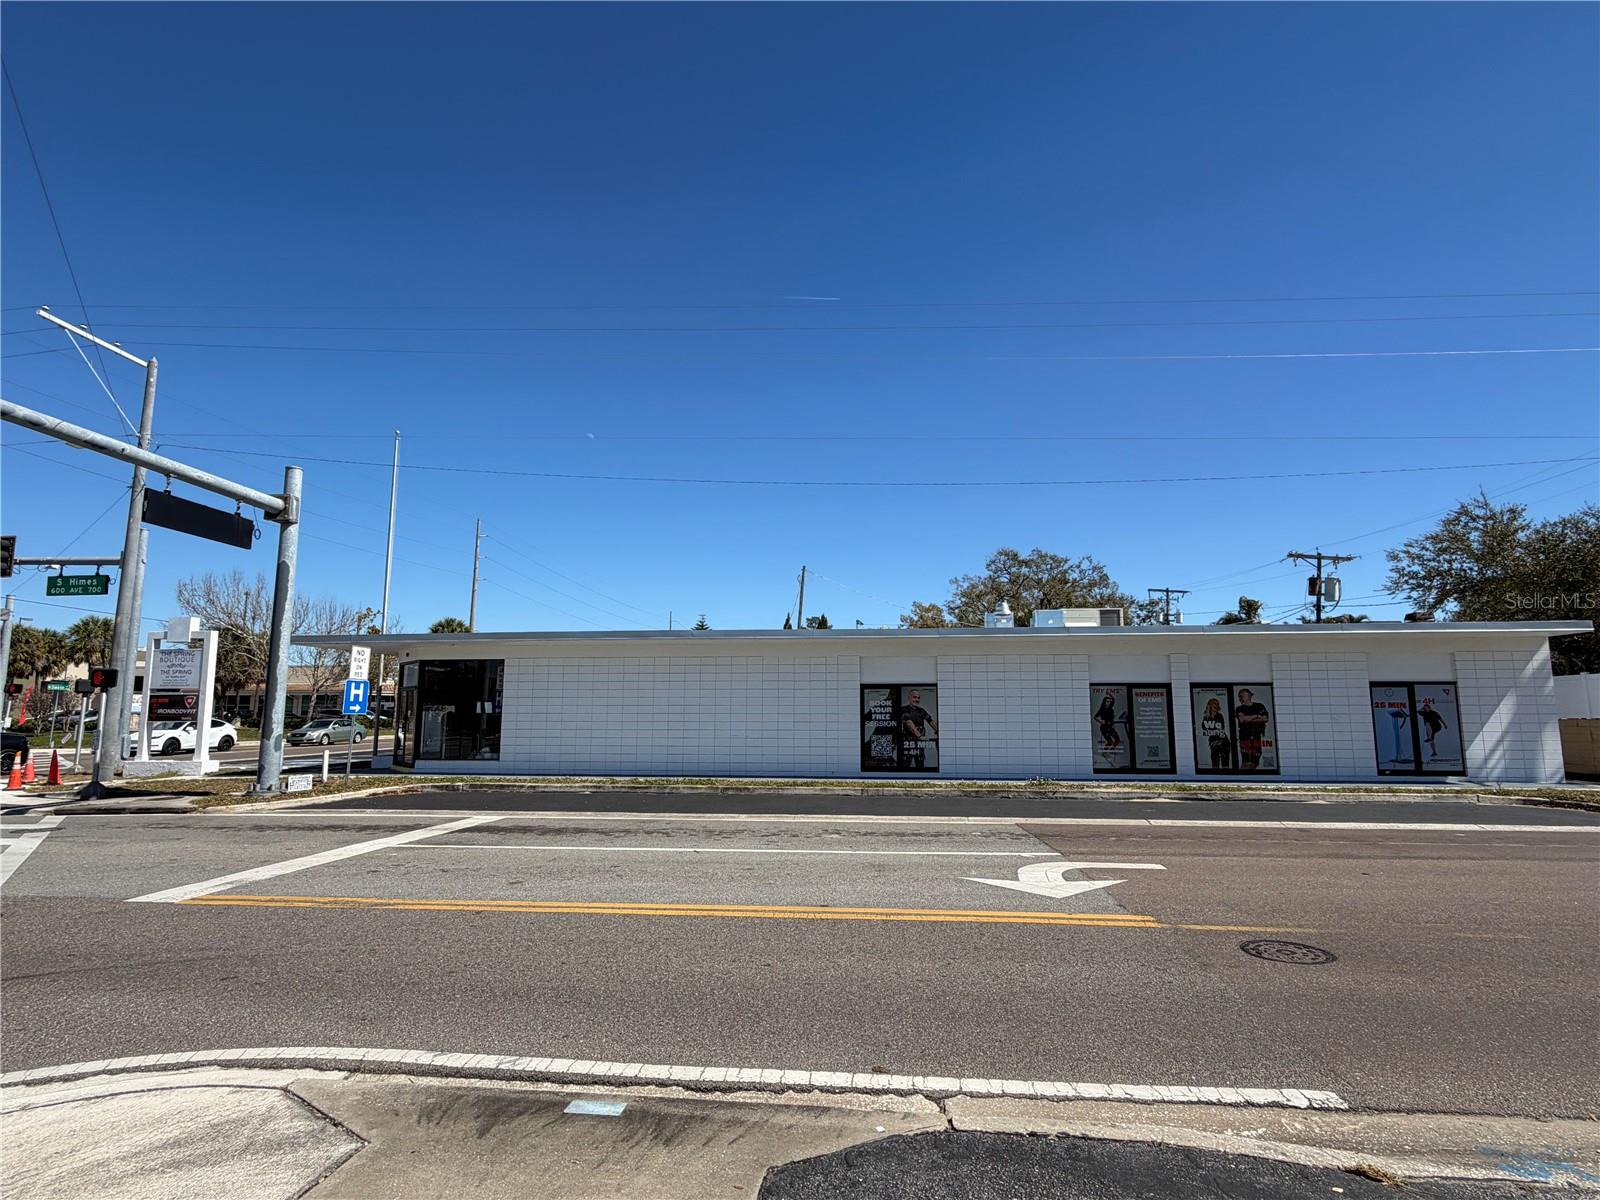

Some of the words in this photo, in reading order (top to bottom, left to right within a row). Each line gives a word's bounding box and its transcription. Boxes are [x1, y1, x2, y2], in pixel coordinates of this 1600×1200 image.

[57, 578, 62, 586] S
[350, 682, 364, 702] H
[1204, 720, 1222, 728] We
